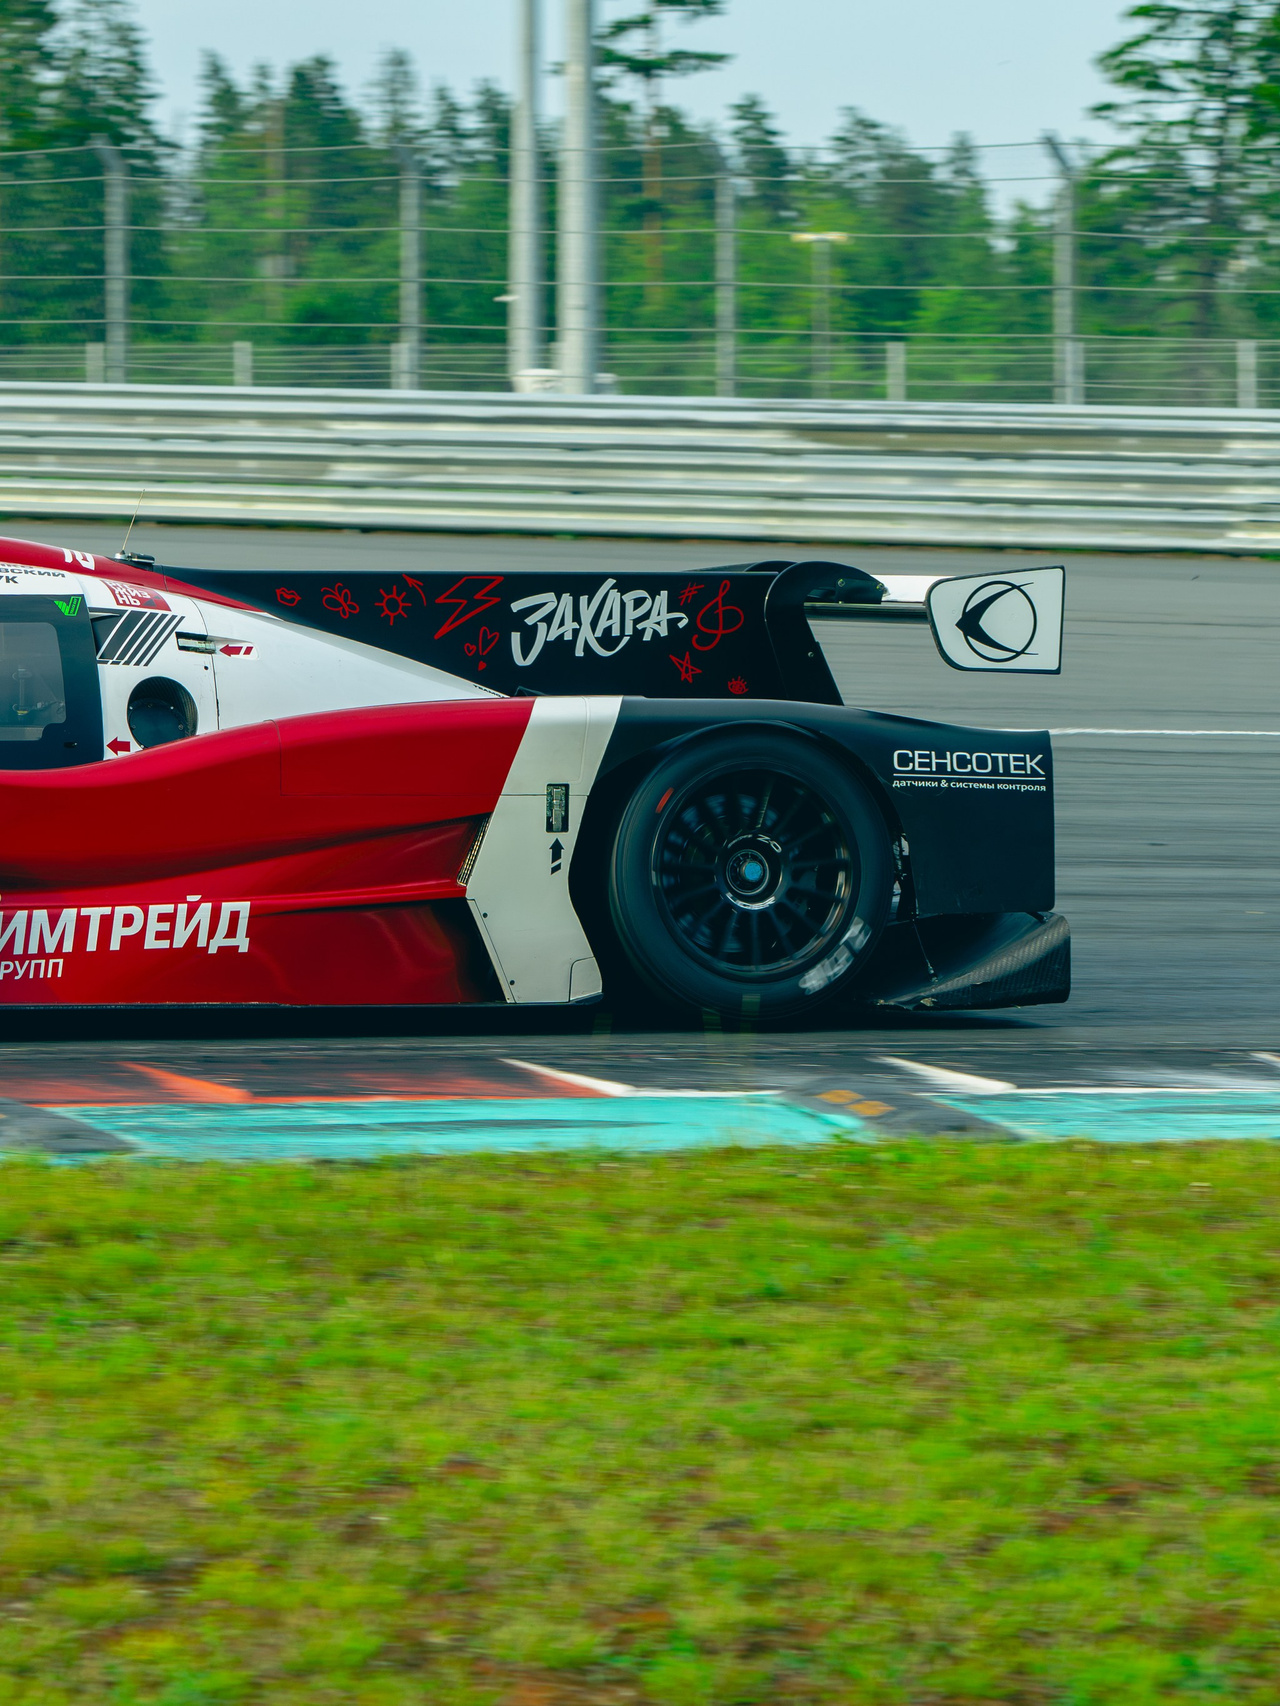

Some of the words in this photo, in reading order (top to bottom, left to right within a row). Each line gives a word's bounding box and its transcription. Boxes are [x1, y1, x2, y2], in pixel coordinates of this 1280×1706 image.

[893, 750, 1045, 775] СЕНСОТЕК
[892, 780, 938, 788] датчики
[950, 782, 995, 790] системы
[997, 783, 1046, 792] контроля
